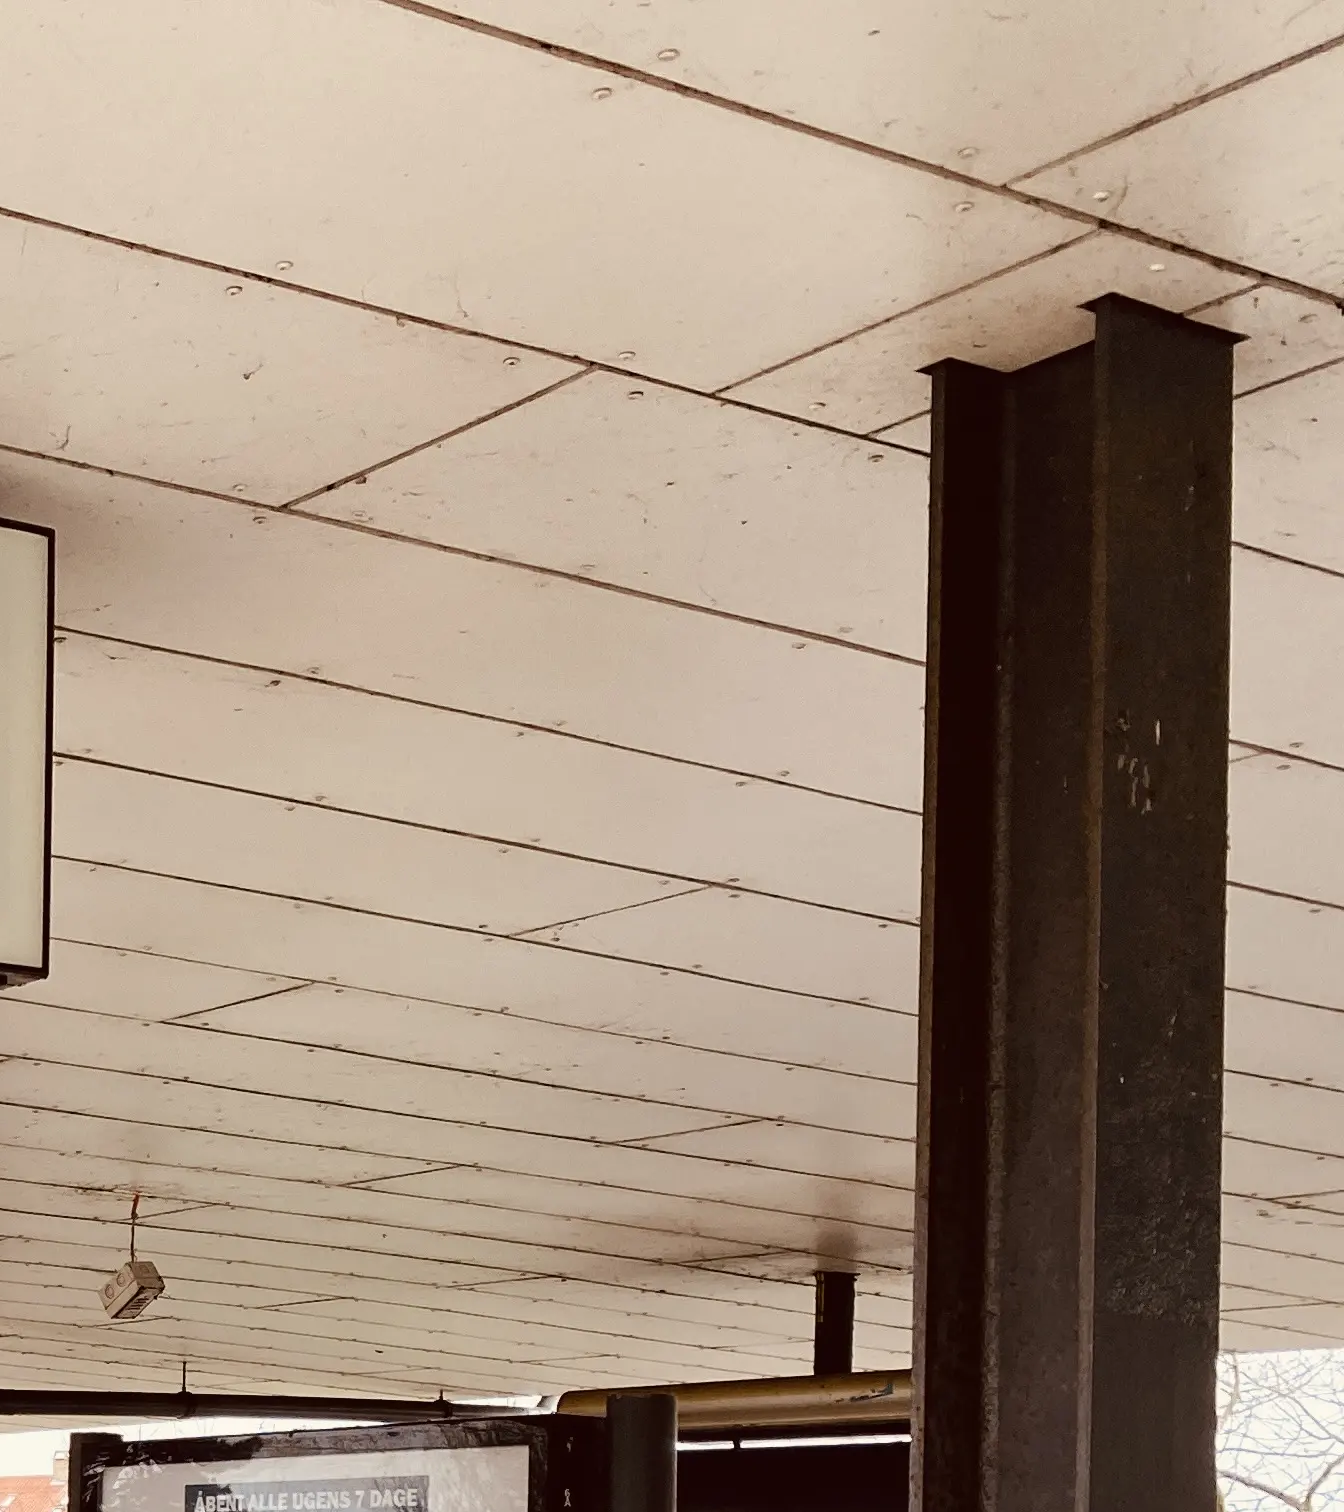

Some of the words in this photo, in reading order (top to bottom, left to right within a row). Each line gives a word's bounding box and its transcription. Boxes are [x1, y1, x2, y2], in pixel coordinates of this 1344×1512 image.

[247, 1492, 288, 1511] ALLE
[292, 1491, 351, 1511] UGENS
[355, 1490, 365, 1510] 7
[369, 1488, 418, 1508] DAGE
